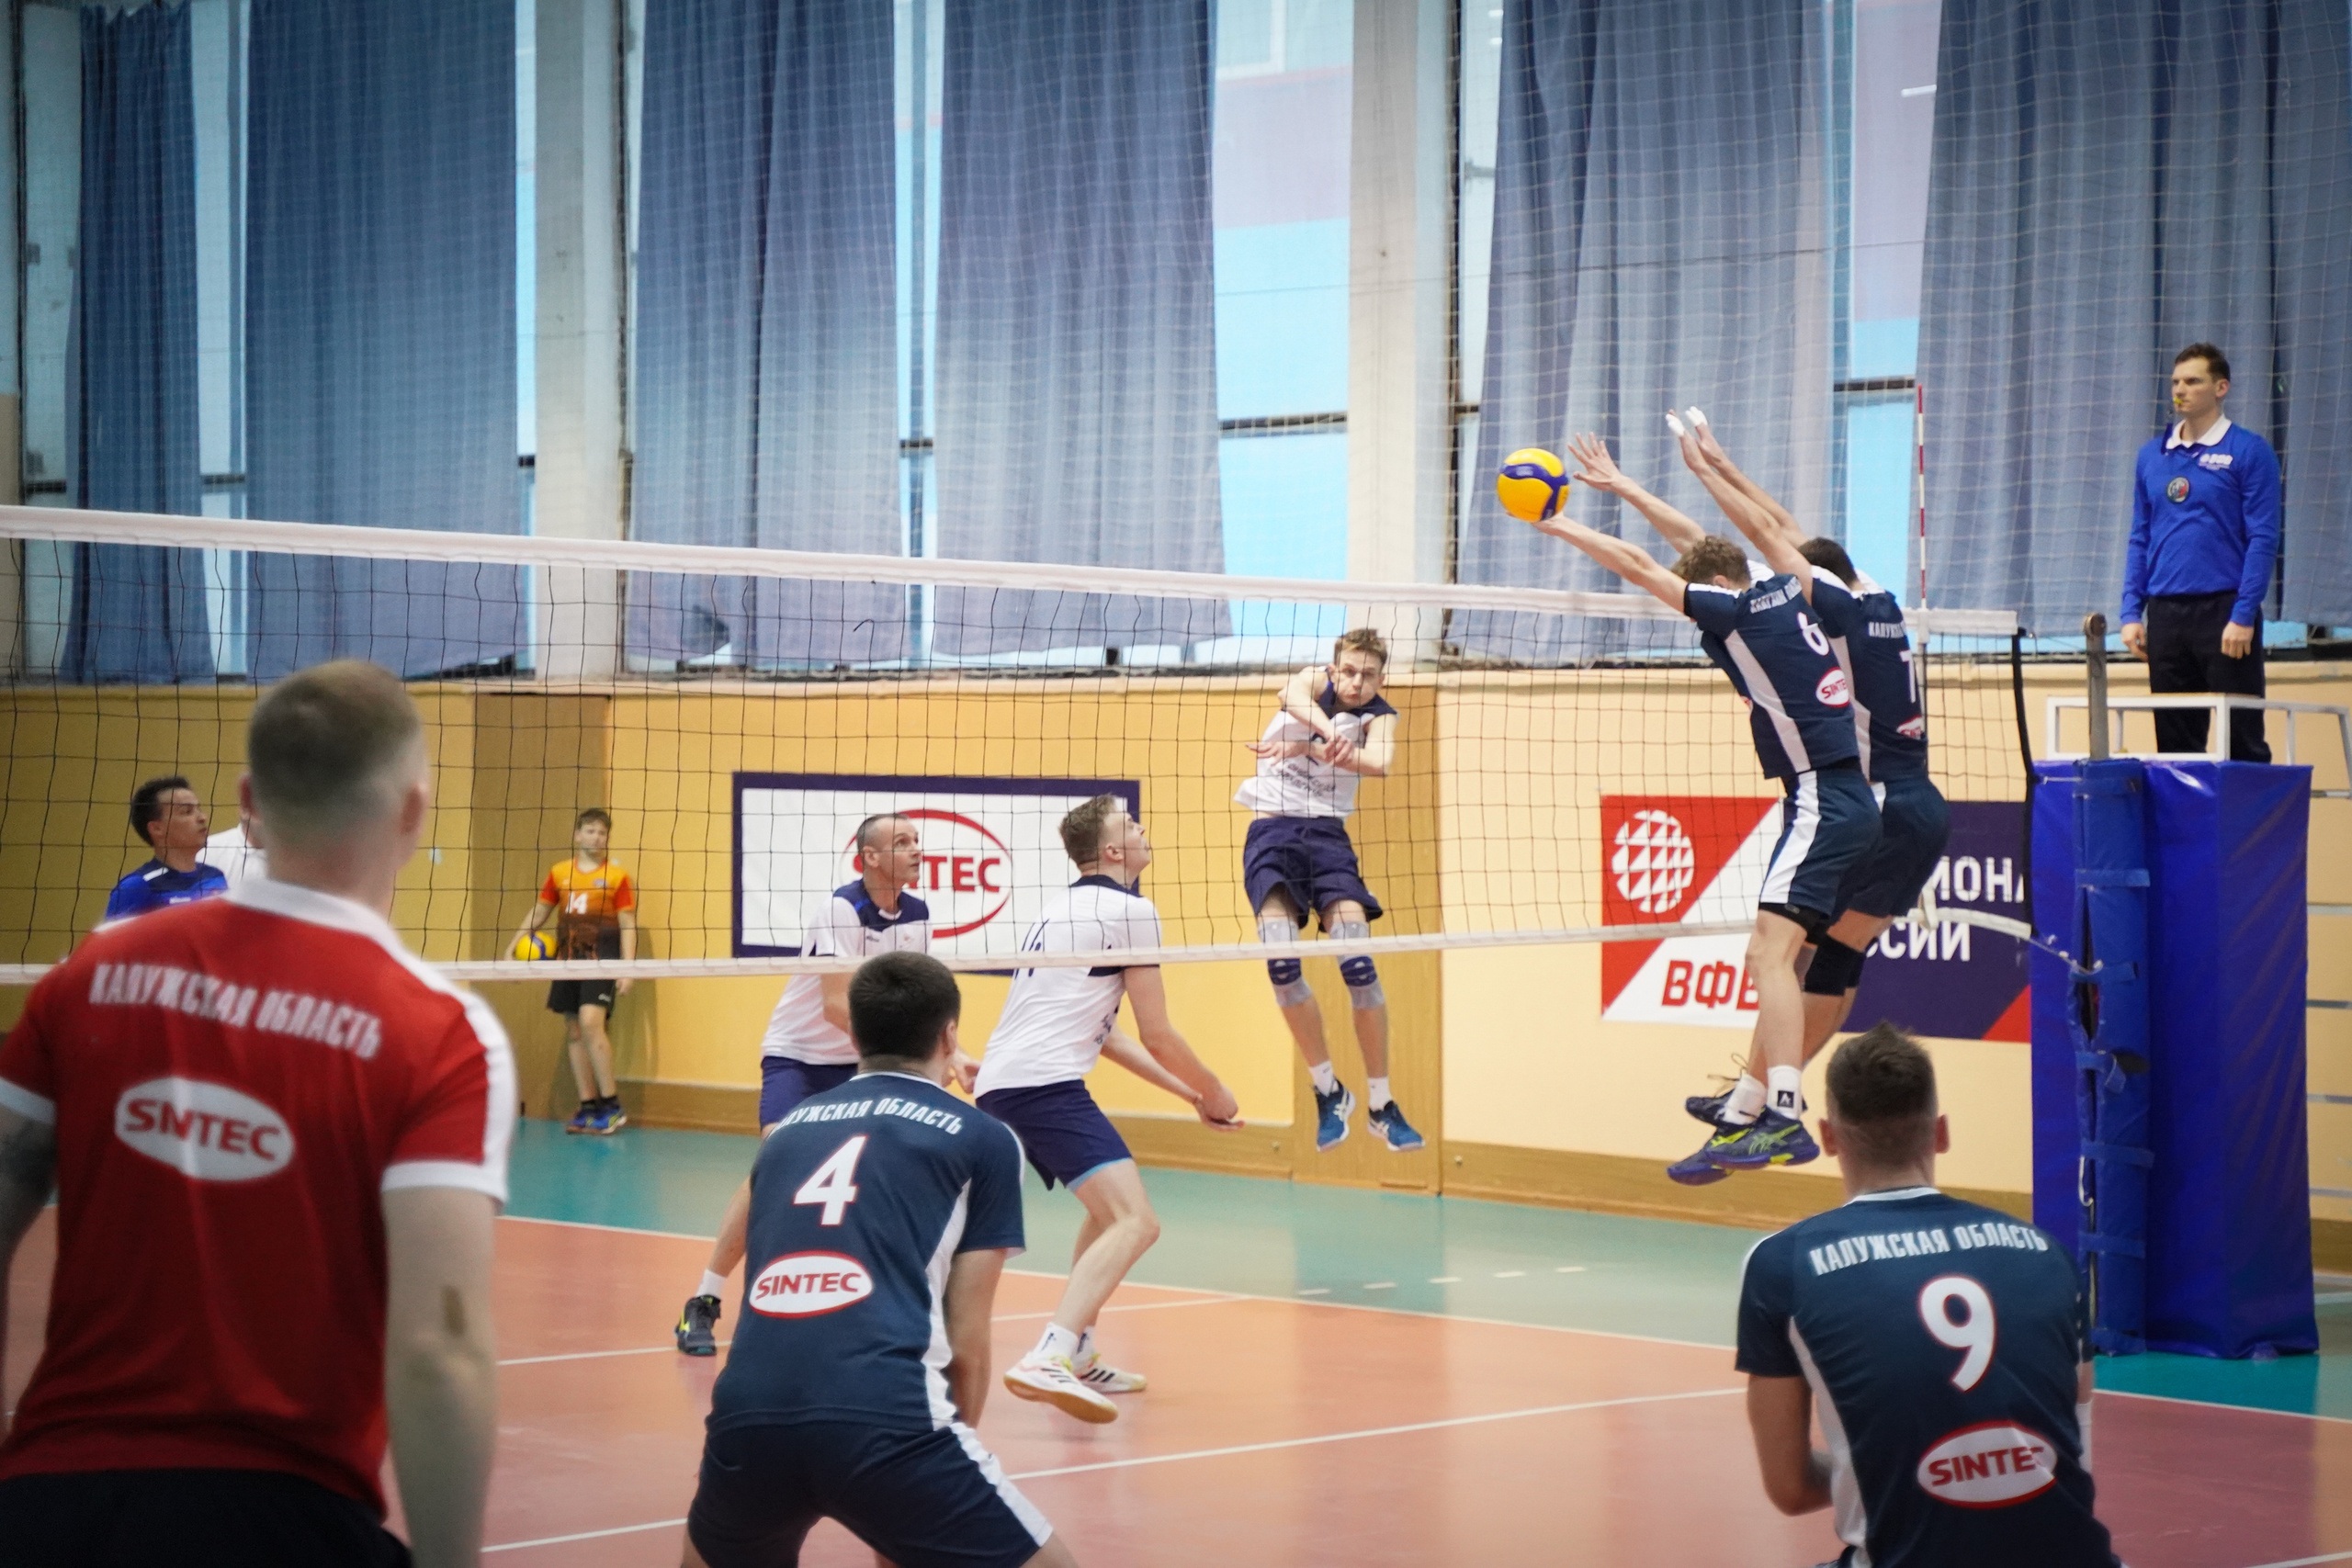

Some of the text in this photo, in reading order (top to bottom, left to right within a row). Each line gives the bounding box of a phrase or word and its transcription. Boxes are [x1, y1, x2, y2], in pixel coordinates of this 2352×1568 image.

[1797, 611, 1829, 657] 6
[853, 854, 1001, 894] TEC
[564, 892, 588, 915] 14
[254, 989, 381, 1060] ОБЛАСТЬ
[873, 1098, 964, 1135] ОБЛАСТЬ
[793, 1134, 869, 1227] 4
[1809, 1222, 2049, 1276] КАЛУЖСКАЯ ОБЛАСТЬ
[755, 1272, 862, 1299] SINTEC
[1918, 1273, 1996, 1393] 9
